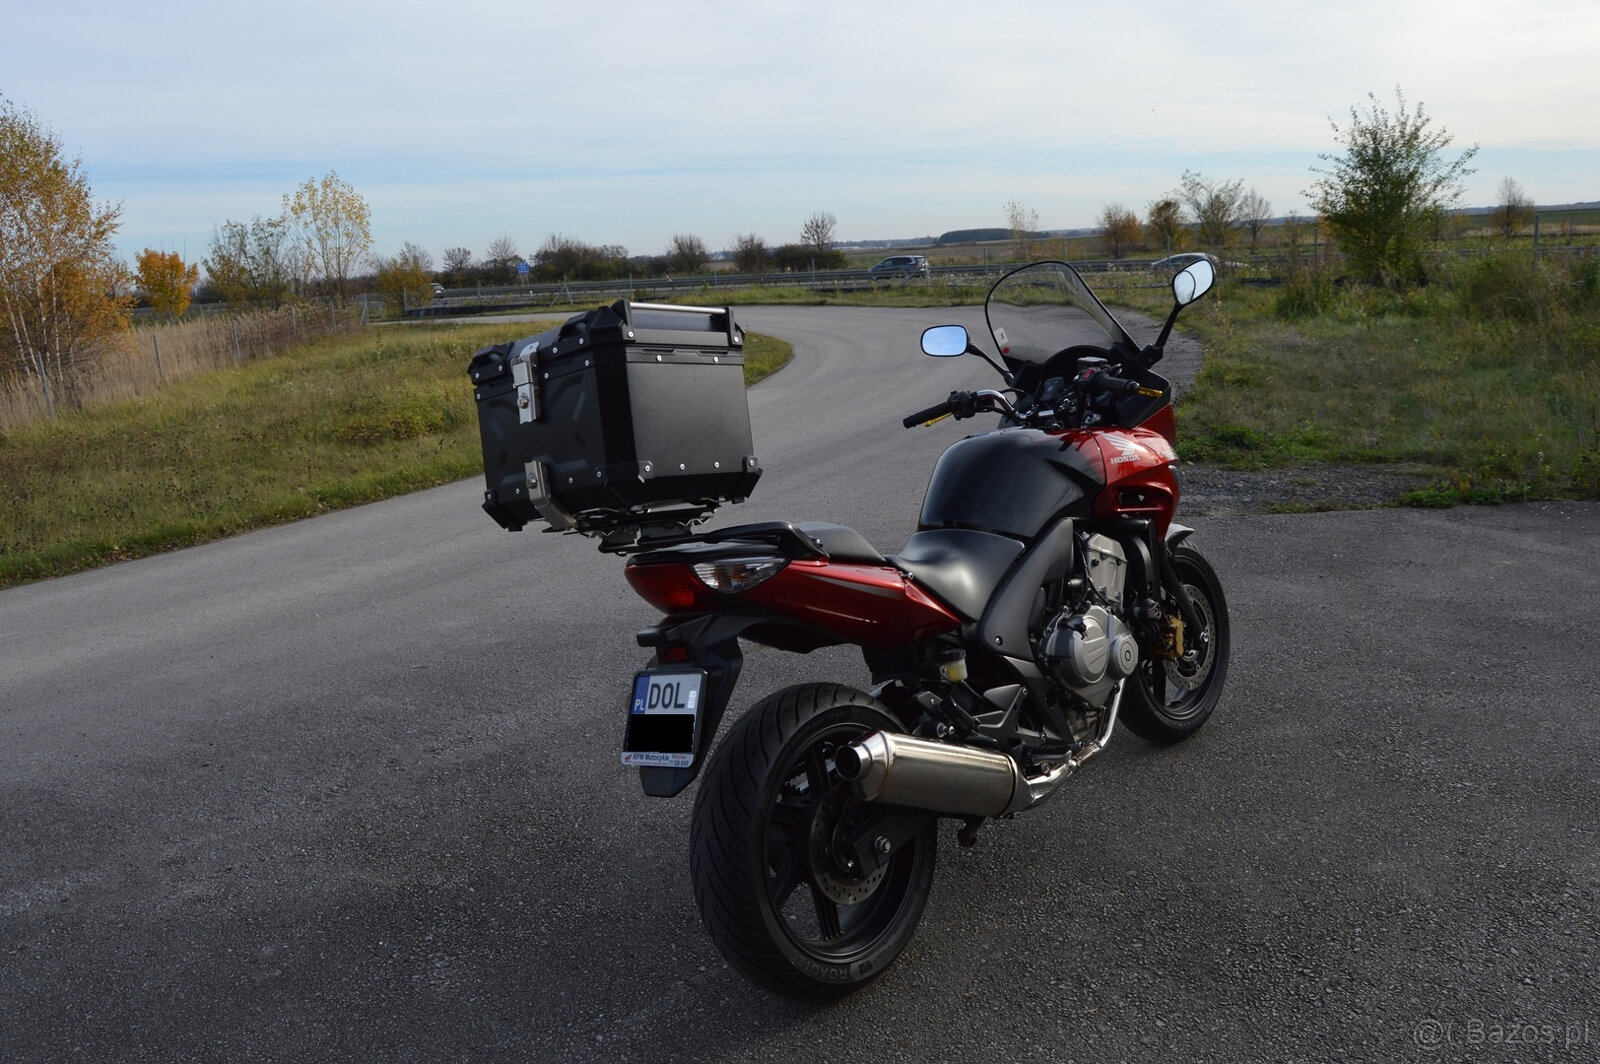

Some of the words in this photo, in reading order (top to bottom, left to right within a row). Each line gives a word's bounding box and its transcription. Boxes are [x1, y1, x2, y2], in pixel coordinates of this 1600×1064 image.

[1110, 454, 1140, 465] HONDA
[634, 699, 645, 711] PL
[648, 682, 685, 709] DOL
[645, 753, 669, 763] Motocykle
